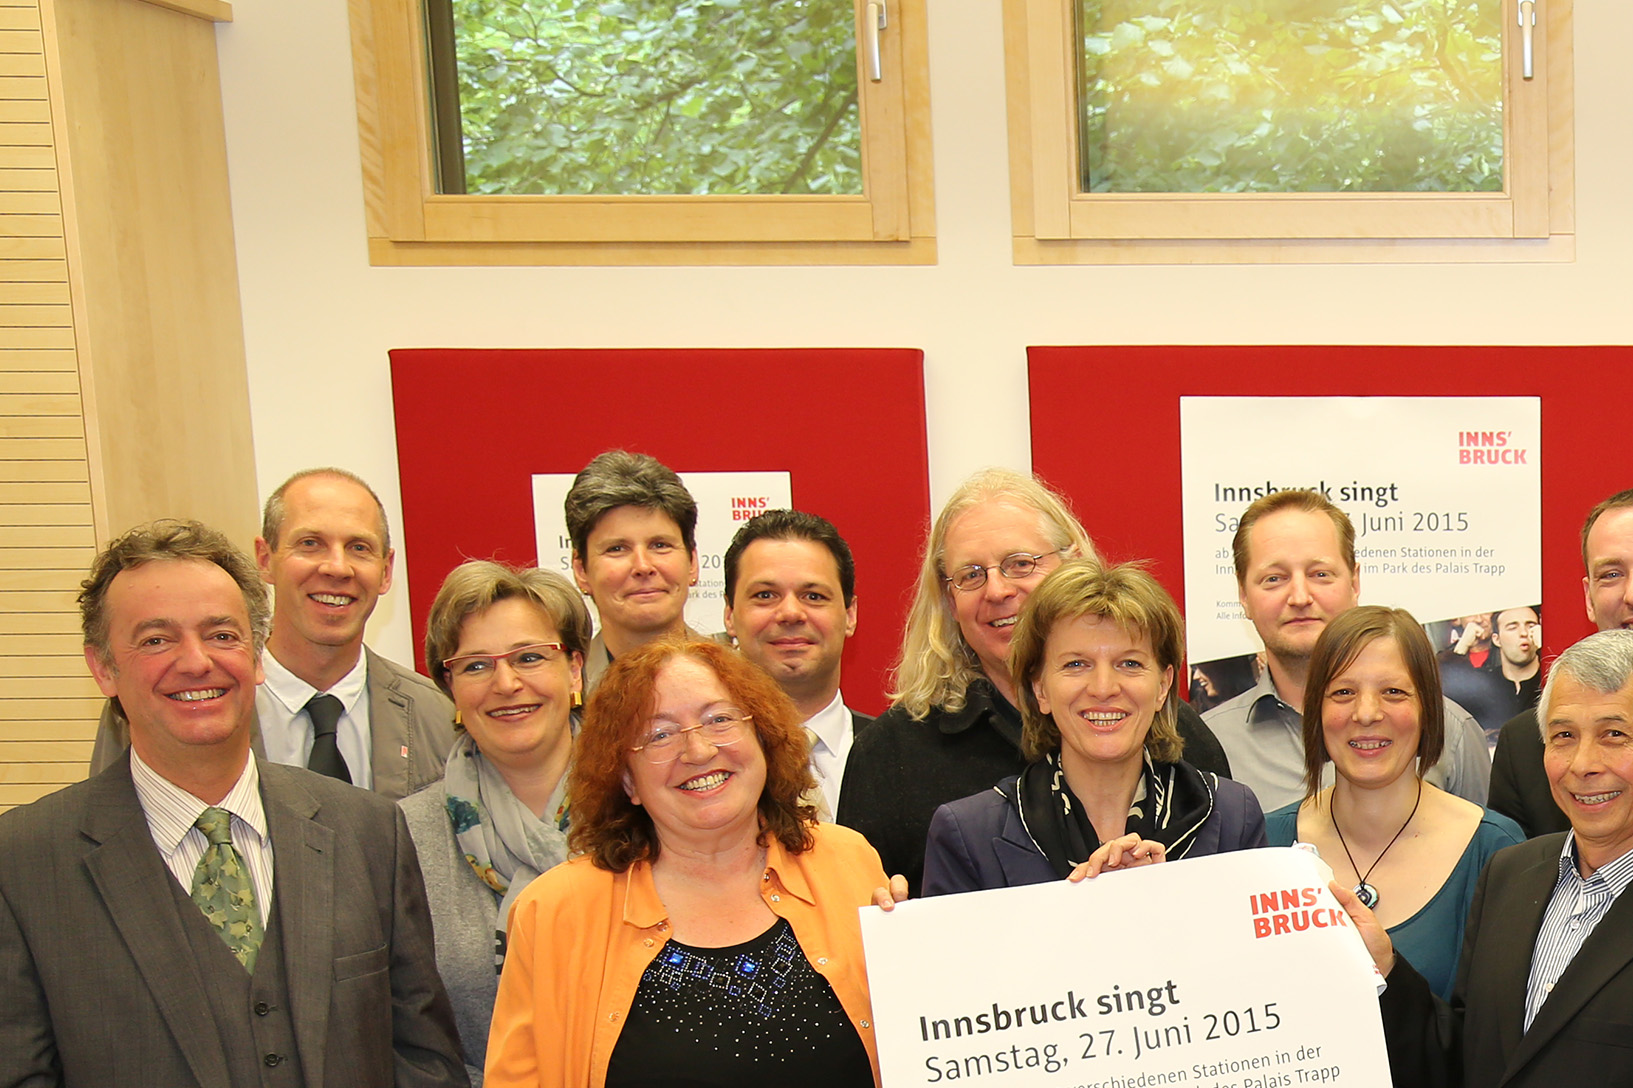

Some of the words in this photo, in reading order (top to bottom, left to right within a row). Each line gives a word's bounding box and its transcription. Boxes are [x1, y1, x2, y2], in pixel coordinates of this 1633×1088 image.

[1458, 449, 1527, 465] BRUCK
[1339, 481, 1399, 507] singt
[732, 509, 767, 521] BRU
[1361, 511, 1404, 537] Juni
[1412, 512, 1469, 532] 2015
[1215, 547, 1229, 558] ab
[1400, 546, 1457, 558] Stationen
[1461, 546, 1472, 557] in
[1475, 546, 1495, 557] der
[1364, 563, 1379, 573] im
[1383, 562, 1408, 573] Park
[1411, 562, 1432, 573] des
[1436, 562, 1470, 573] Palais
[1473, 563, 1506, 576] Trapp
[688, 590, 700, 599] ark
[1253, 908, 1348, 939] BRUCK
[919, 990, 1088, 1042] Innsbruck
[1096, 979, 1181, 1017] singt
[925, 1043, 1069, 1083] Samstag,
[1078, 1029, 1123, 1060] 27.
[1133, 1016, 1192, 1060] Juni
[1202, 1002, 1281, 1041] 2015
[1192, 1055, 1271, 1080] Stationen
[1275, 1049, 1291, 1065] in
[1296, 1044, 1322, 1062] der
[1294, 1065, 1341, 1084] Trapp
